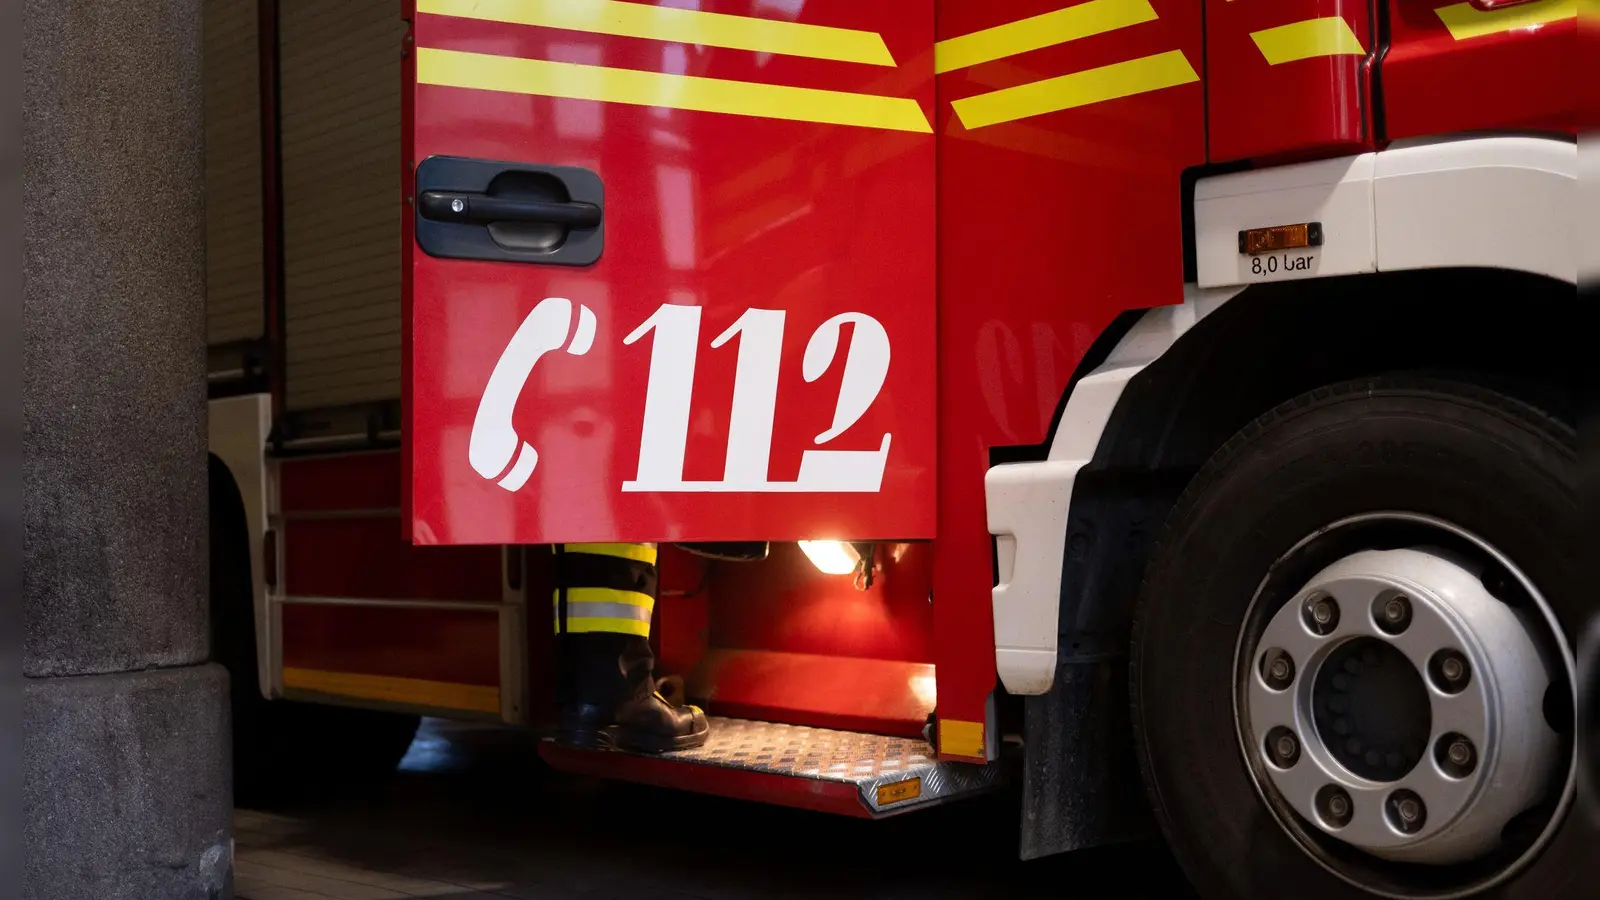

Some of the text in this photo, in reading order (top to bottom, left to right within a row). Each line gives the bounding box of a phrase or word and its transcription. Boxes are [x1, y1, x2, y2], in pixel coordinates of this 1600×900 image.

[1251, 254, 1314, 276] 8,0 bar
[622, 303, 892, 492] 112
